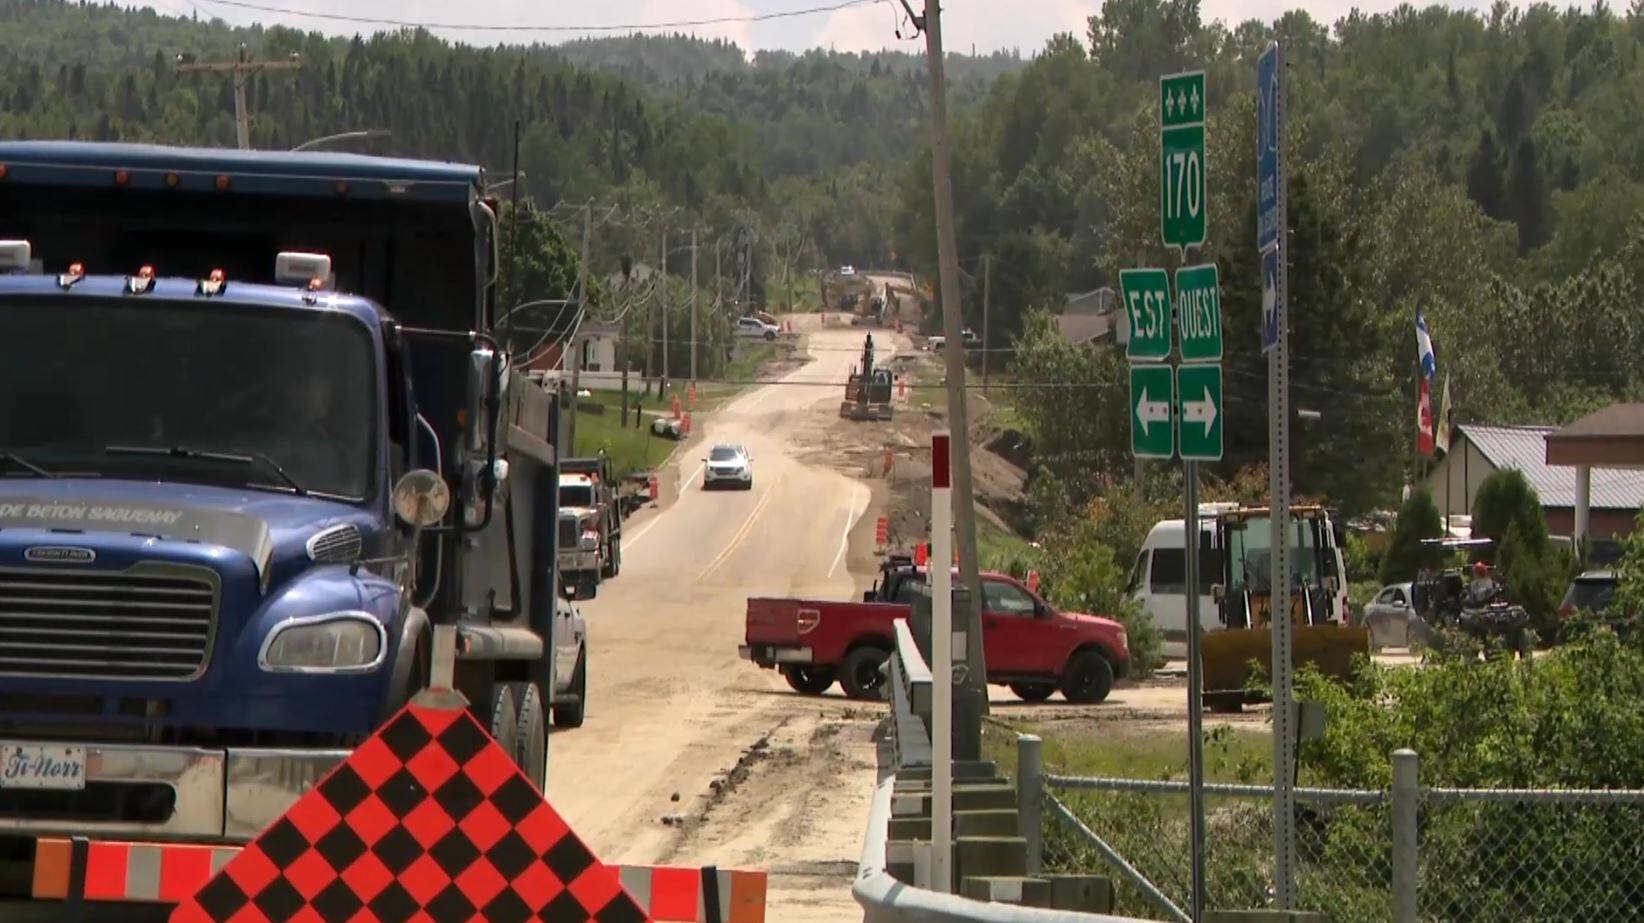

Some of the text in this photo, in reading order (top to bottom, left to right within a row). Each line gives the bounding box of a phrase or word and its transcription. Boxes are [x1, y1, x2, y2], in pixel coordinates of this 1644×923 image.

[1166, 151, 1200, 219] 170
[1129, 289, 1165, 339] EST
[1179, 287, 1218, 340] OUEST
[0, 504, 26, 518] DE
[88, 506, 183, 525] SAGUENAY
